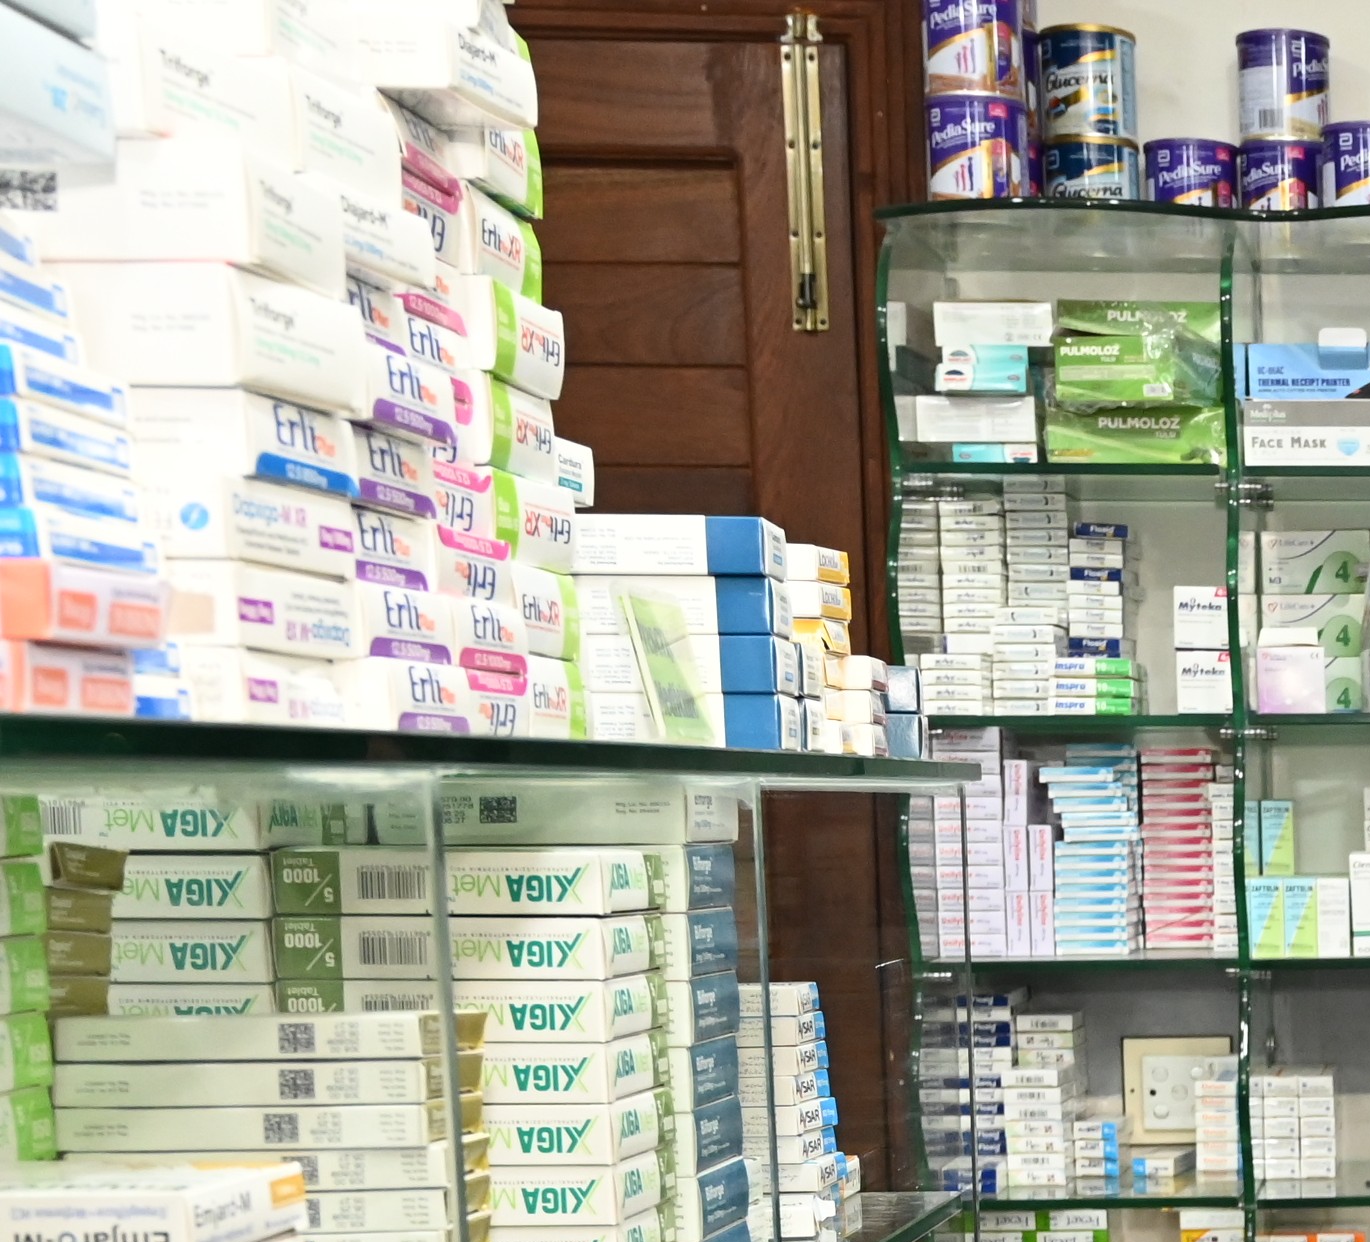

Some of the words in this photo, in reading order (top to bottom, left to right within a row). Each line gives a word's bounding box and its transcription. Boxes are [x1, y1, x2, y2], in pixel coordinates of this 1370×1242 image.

[1045, 72, 1115, 94] Glucerna
[931, 120, 995, 150] PediaSure
[1159, 162, 1221, 188] PediaSure
[1060, 346, 1120, 356] PULMOLOZ
[1257, 377, 1286, 387] THERMAL
[1290, 377, 1319, 387] RECEIPT
[1321, 377, 1351, 387] PRINTER
[1098, 416, 1180, 430] PULMOLOZ
[1251, 437, 1284, 449] FACE
[1290, 436, 1327, 449] MASK
[164, 867, 249, 908] XIGA
[283, 867, 322, 884] 1000
[506, 867, 590, 903] XIGA
[170, 930, 254, 971] XIGA
[284, 931, 323, 949] 1000
[507, 932, 591, 968] XIGA
[509, 996, 590, 1032] XIGA
[513, 1056, 592, 1093] XIGA
[517, 1119, 592, 1154] XIGA
[521, 1179, 597, 1215] XIGA
